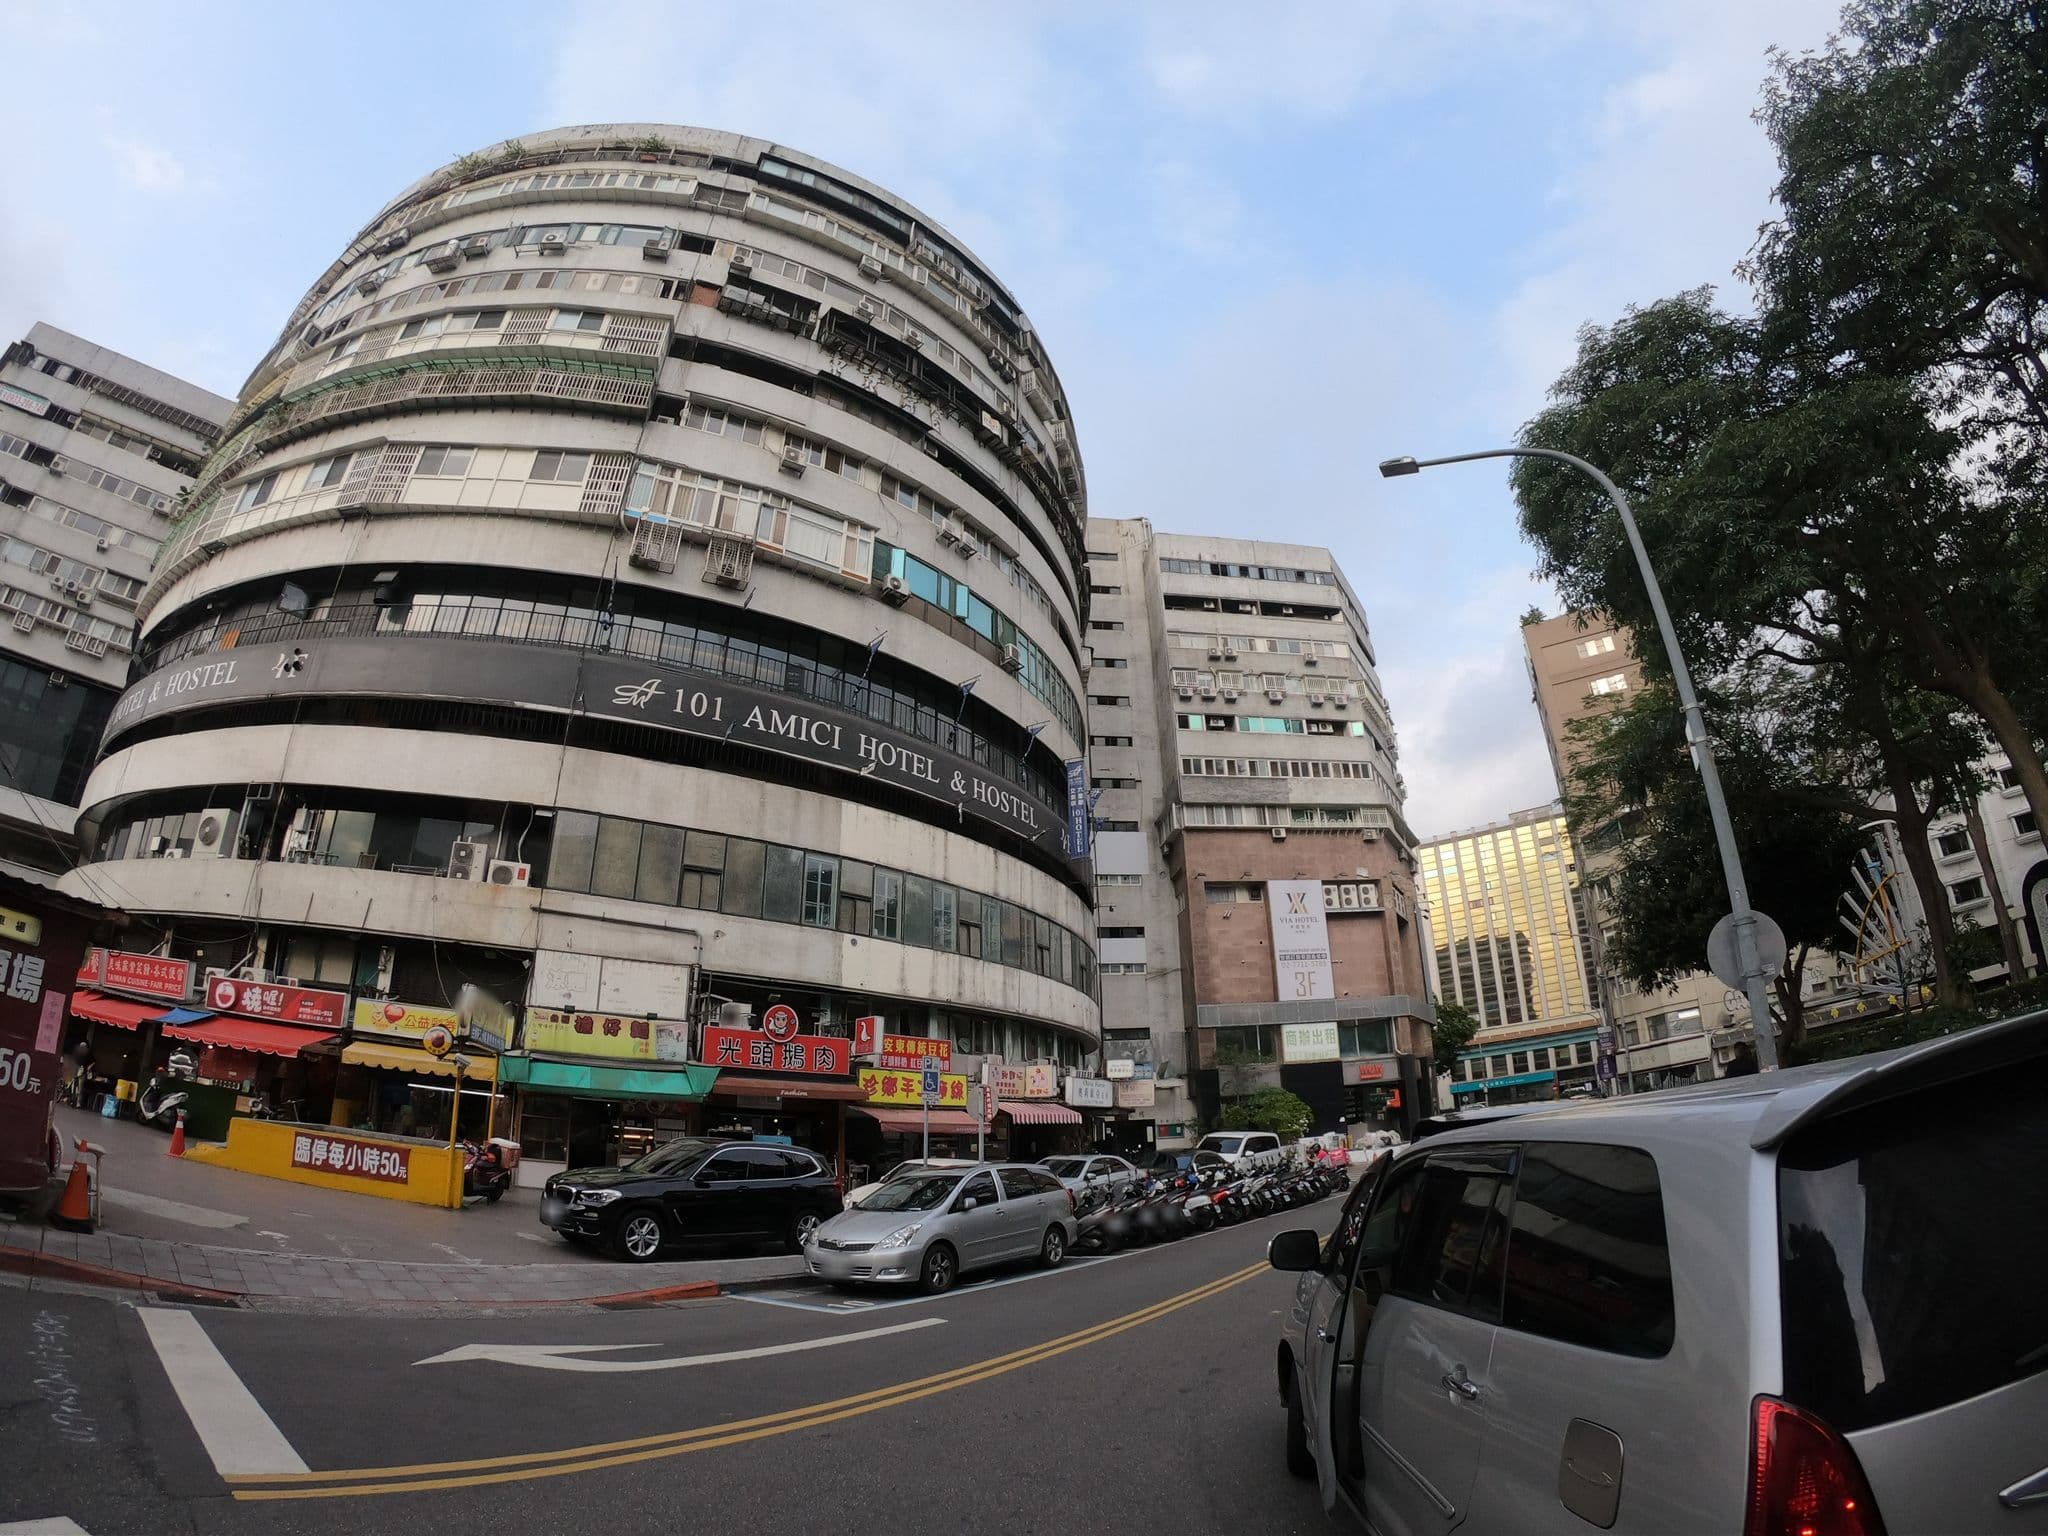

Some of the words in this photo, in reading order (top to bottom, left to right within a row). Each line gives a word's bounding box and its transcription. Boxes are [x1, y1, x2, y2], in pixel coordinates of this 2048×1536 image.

[148, 681, 161, 703] &
[165, 660, 239, 697] HOSTEL
[672, 688, 724, 722] 101
[742, 705, 843, 750] AMICI
[858, 733, 941, 784] HOTEL
[950, 770, 967, 795] &
[972, 777, 1039, 829] HOSTEL
[1295, 916, 1319, 924] HOTEL
[164, 982, 182, 993] PRICE
[1294, 971, 1317, 997] 3F
[717, 1036, 836, 1073] 光頭鵝肉
[883, 1037, 949, 1058] 安東傳統豆花
[924, 1058, 932, 1068] P
[294, 1135, 407, 1179] 臨停每小時50元
